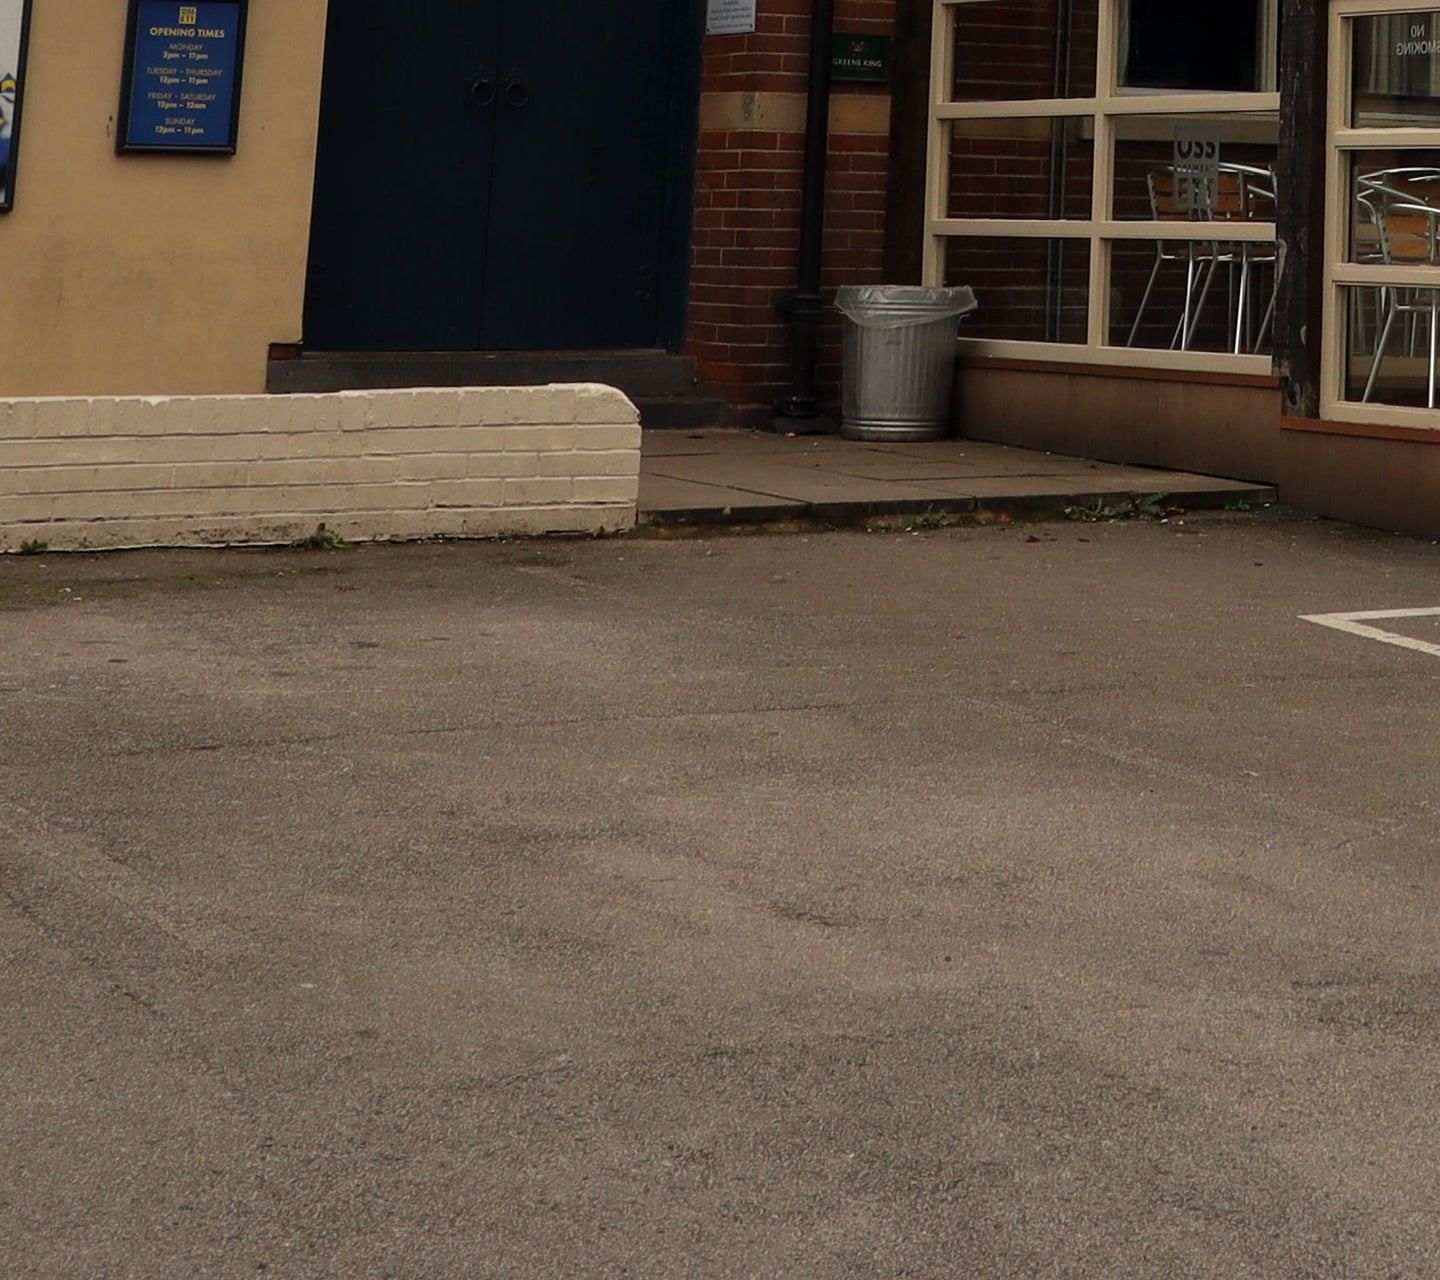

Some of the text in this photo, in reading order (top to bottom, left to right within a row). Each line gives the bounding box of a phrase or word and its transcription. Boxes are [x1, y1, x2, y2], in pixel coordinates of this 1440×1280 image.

[149, 27, 225, 38] OPENING TIMES
[863, 60, 881, 68] KING
